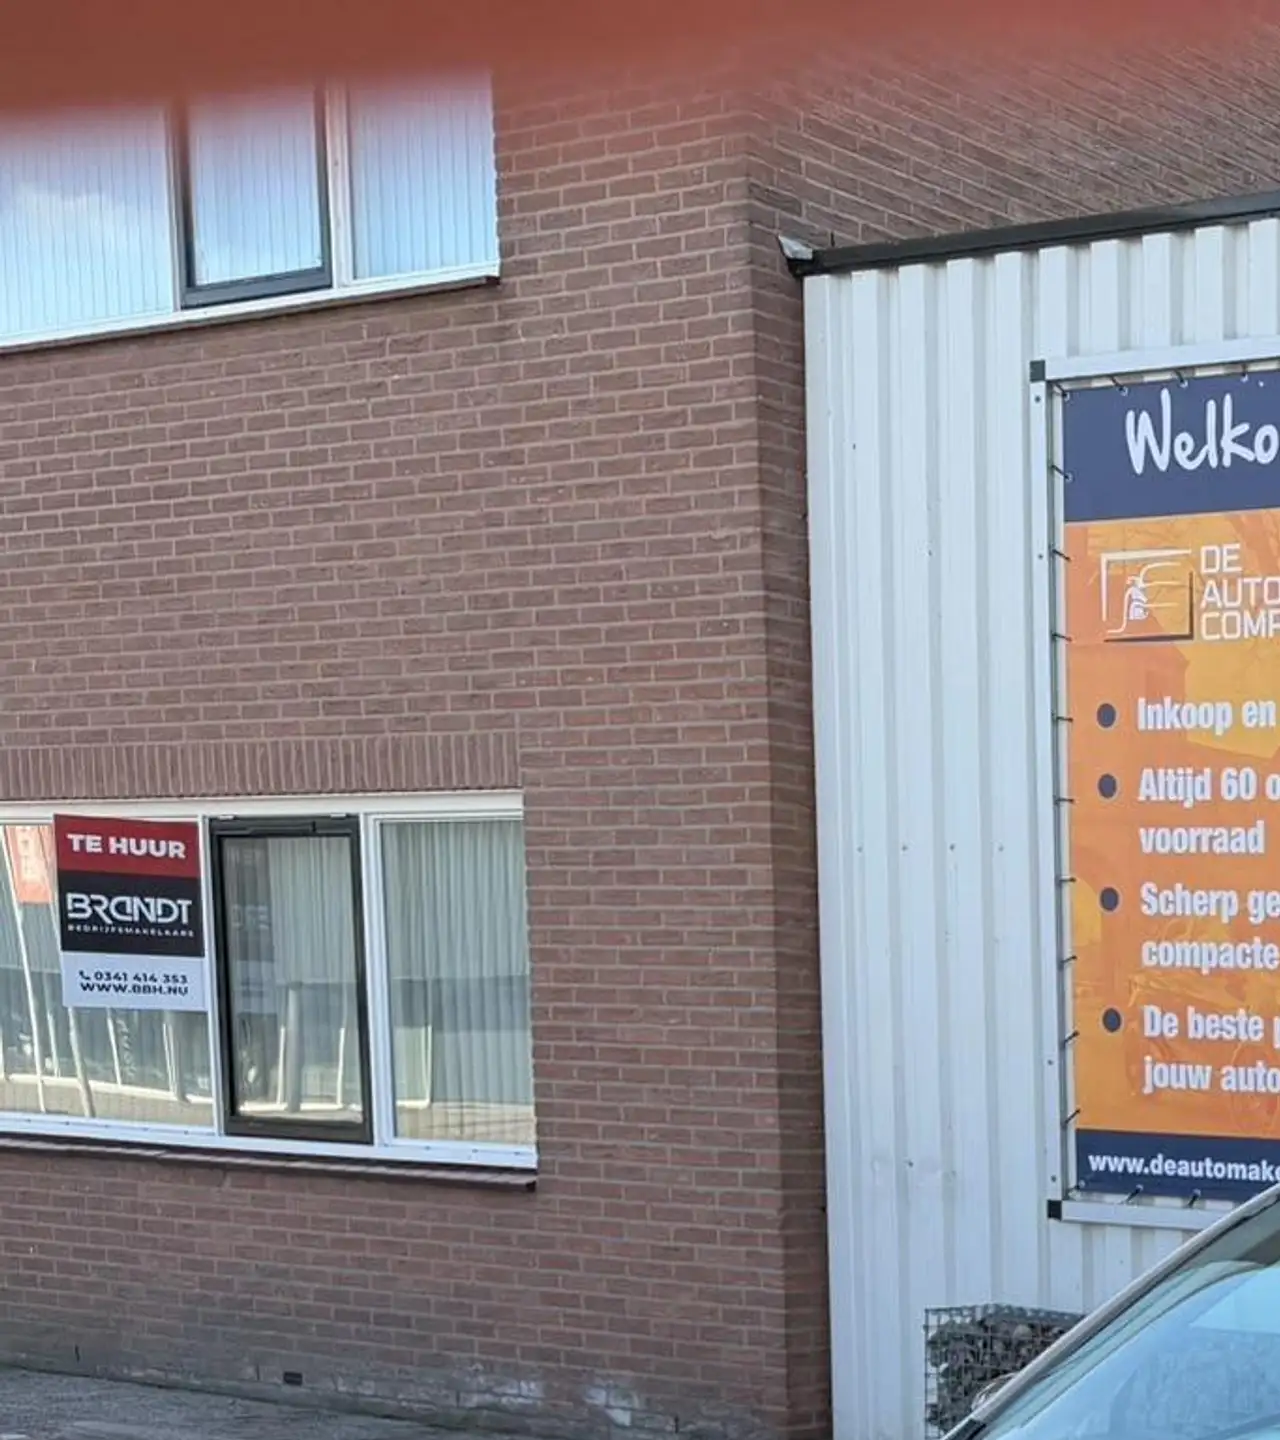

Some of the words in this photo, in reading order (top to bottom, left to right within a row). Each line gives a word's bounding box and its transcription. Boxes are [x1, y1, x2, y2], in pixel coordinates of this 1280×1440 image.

[1200, 543, 1241, 574] DE
[1137, 697, 1233, 736] Inkoop
[1241, 701, 1277, 728] en
[1138, 766, 1212, 808] Altijd
[1220, 769, 1257, 800] 60
[67, 833, 103, 853] TE
[109, 836, 187, 859] HUUR
[1138, 819, 1266, 855] voorraad
[1140, 883, 1238, 923] Scherp
[1140, 938, 1280, 975] compacte
[94, 971, 129, 982] 0341
[1142, 1004, 1181, 1040] De
[1187, 1007, 1264, 1042] beste
[1142, 1055, 1212, 1093] jouw
